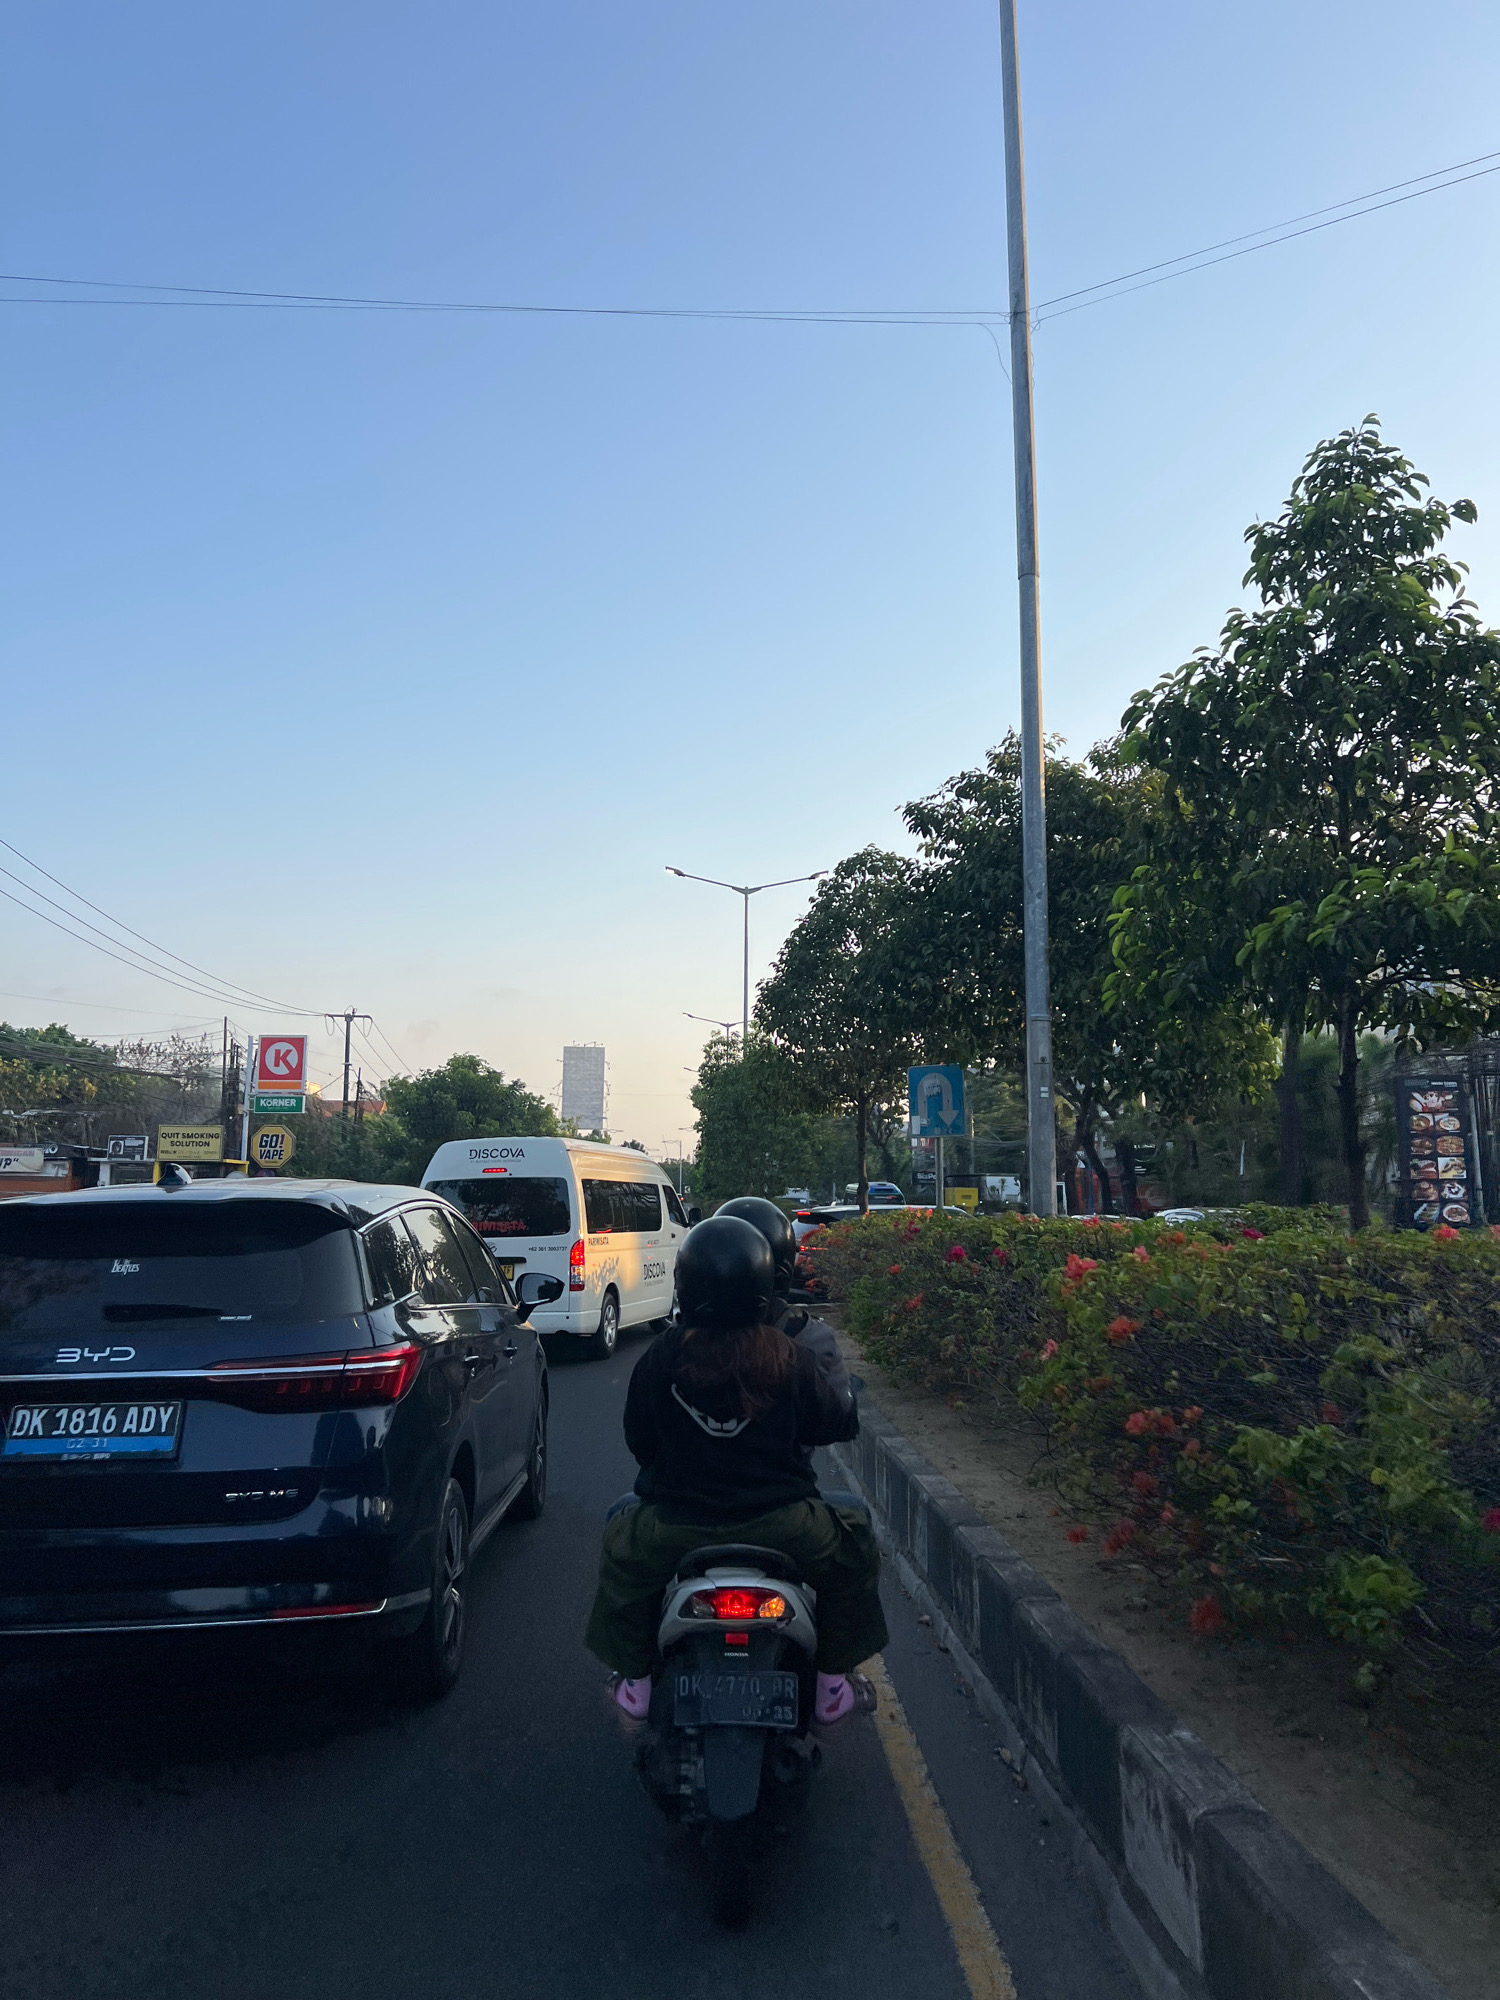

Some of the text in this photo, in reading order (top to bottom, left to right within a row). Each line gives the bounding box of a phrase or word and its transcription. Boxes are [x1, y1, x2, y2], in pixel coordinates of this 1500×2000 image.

[161, 1132, 220, 1140] QUIT SMOKING
[258, 1134, 286, 1148] GO!
[170, 1140, 211, 1148] SOLUTION
[259, 1149, 285, 1160] VAPE
[468, 1147, 526, 1160] DISCOVA
[56, 1346, 136, 1363] BYD
[12, 1405, 174, 1437] DK 1816 ADY
[680, 1675, 705, 1697] DK
